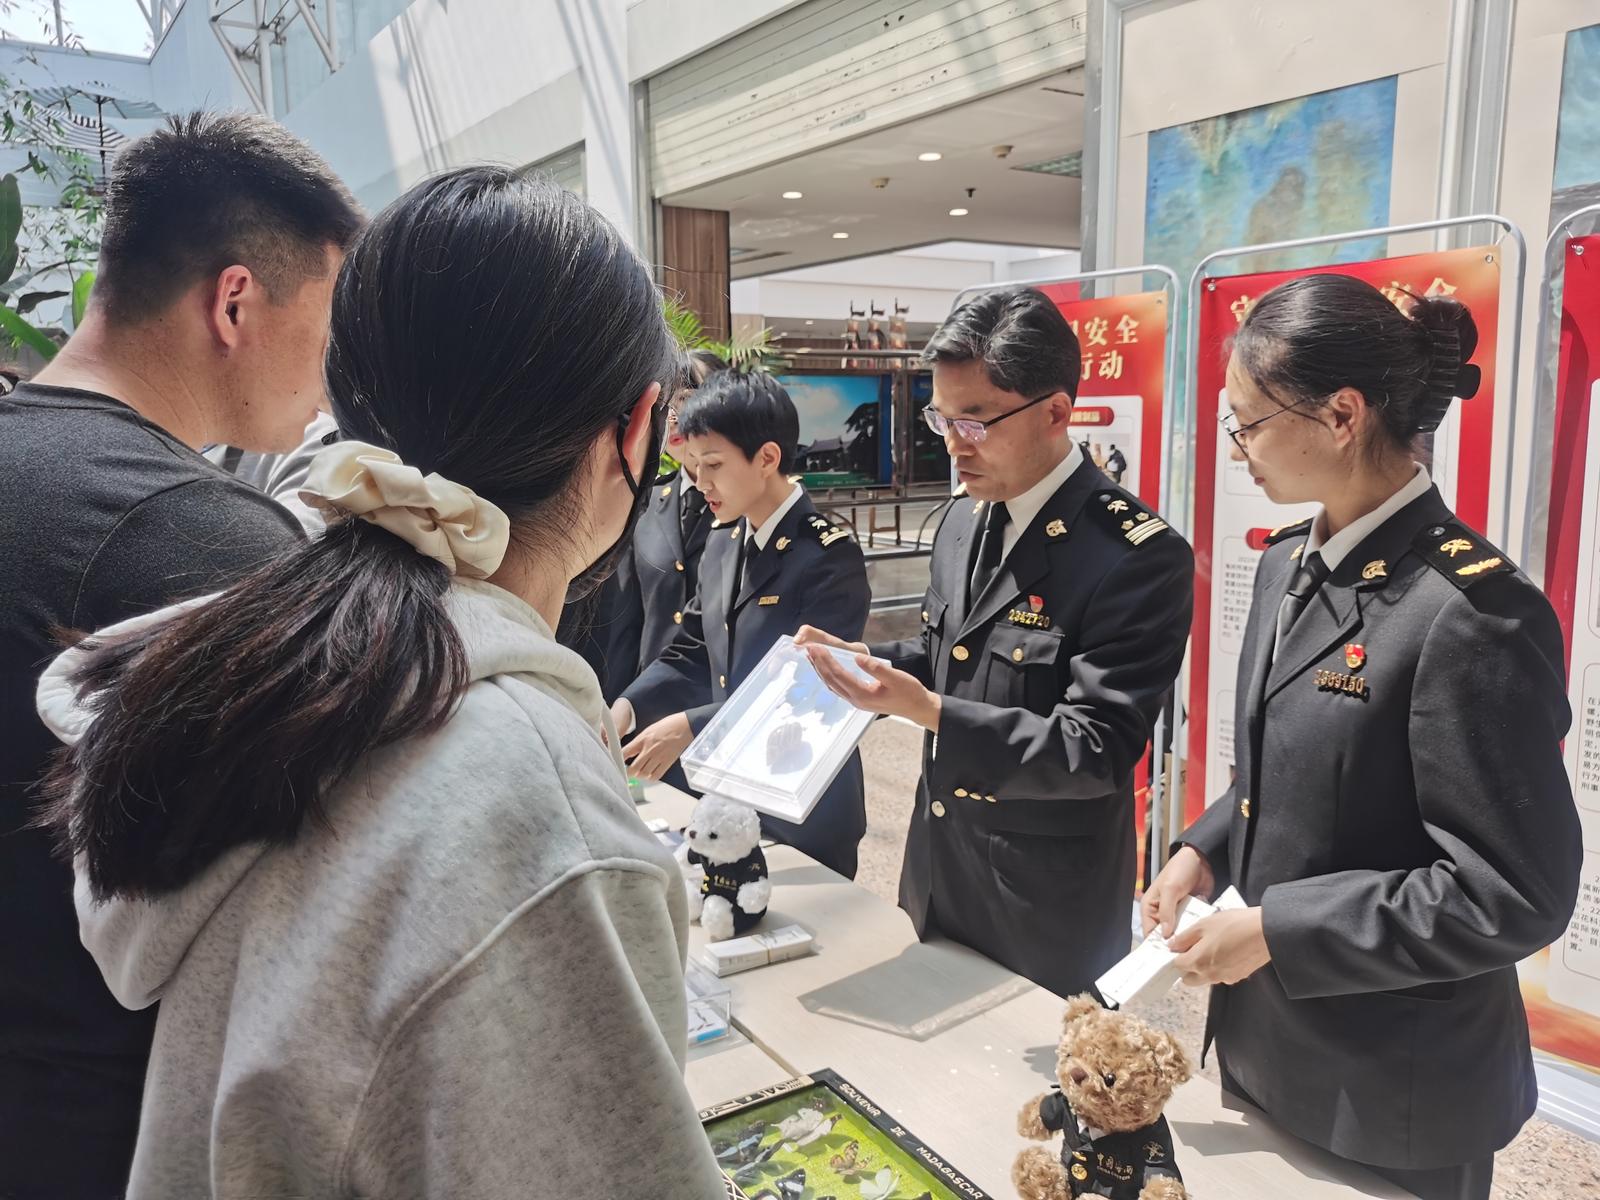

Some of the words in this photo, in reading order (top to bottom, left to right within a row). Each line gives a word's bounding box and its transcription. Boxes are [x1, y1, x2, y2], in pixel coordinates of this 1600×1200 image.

[1071, 314, 1140, 347] 安全
[839, 1083, 881, 1116] SOUVENIR
[890, 1126, 906, 1137] DE
[916, 1146, 984, 1199] MADAGASCAR
